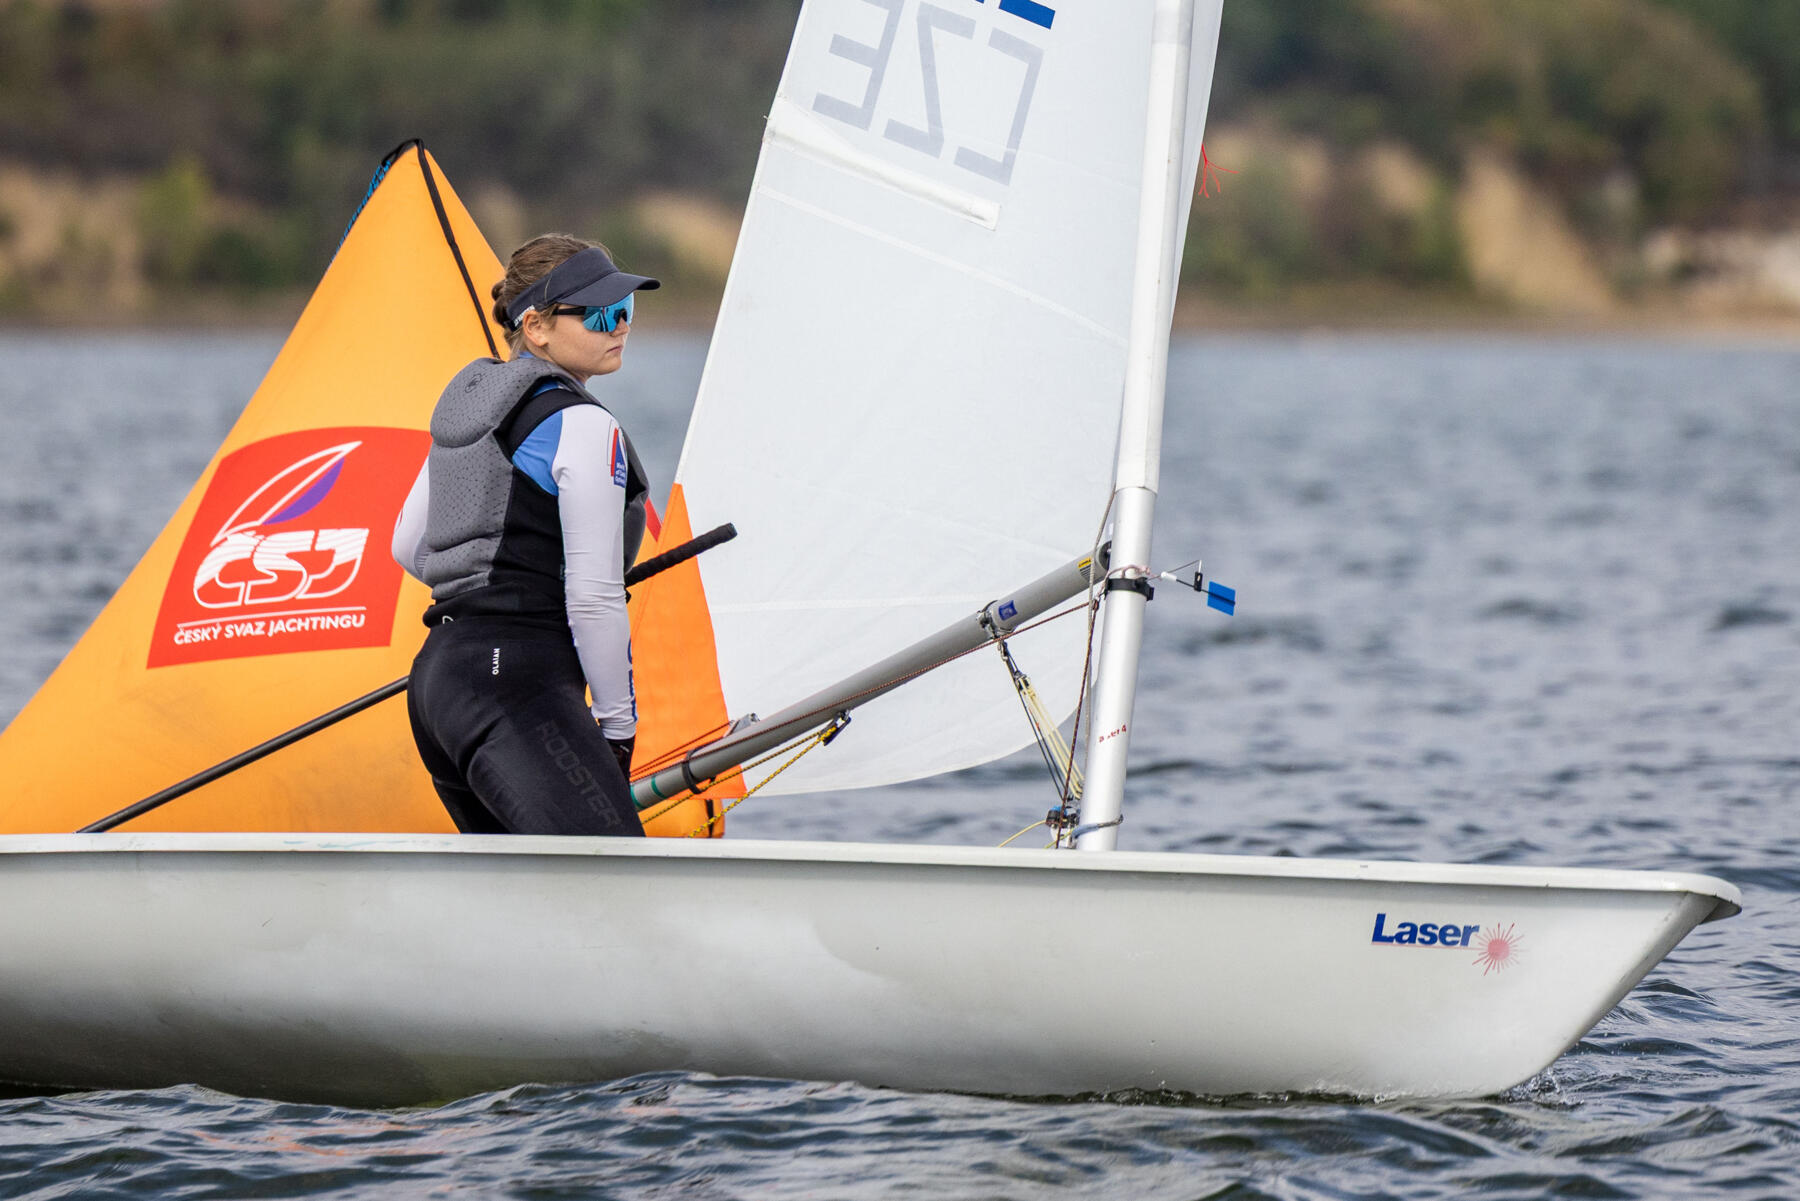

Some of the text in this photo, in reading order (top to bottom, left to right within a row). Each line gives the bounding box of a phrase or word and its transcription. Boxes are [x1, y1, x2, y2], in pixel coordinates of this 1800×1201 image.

[174, 614, 366, 645] ČESKÝ SVAZ JACHTINGU
[492, 648, 500, 675] OLAIAN
[536, 720, 622, 828] ROOSTER
[1372, 913, 1480, 947] Laser
